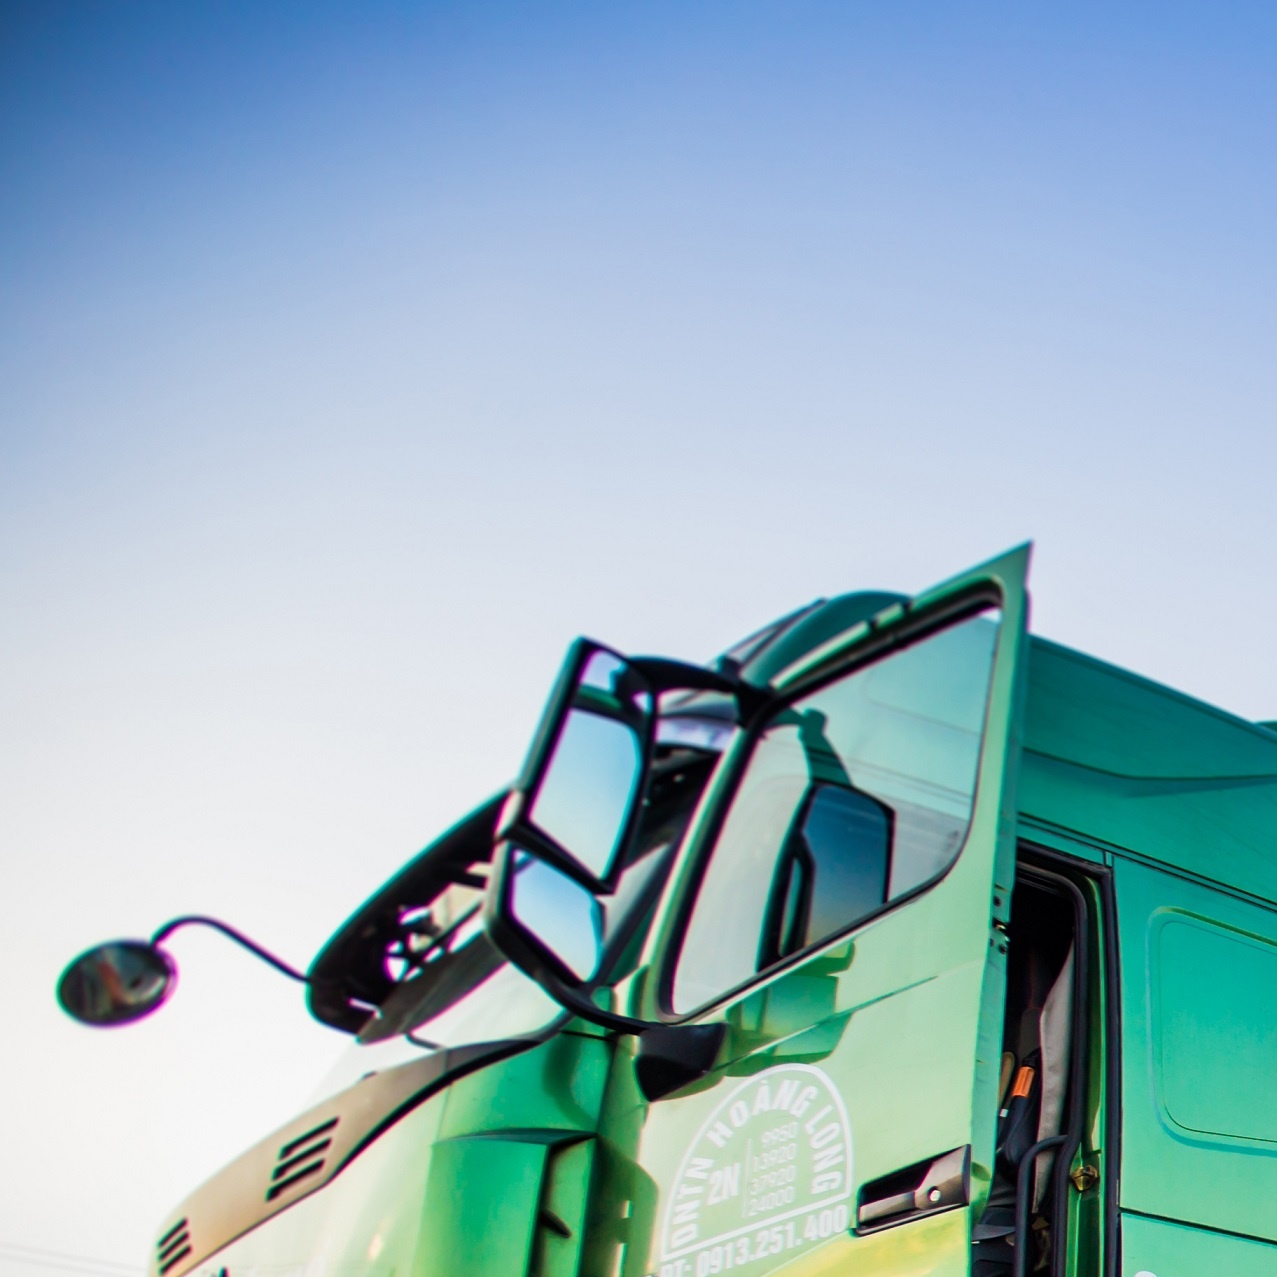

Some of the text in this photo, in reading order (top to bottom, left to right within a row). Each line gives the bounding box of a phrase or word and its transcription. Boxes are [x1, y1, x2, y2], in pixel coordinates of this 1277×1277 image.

[671, 1079, 844, 1248] DNTN HOÀNG LONG
[707, 1162, 741, 1205] 2N
